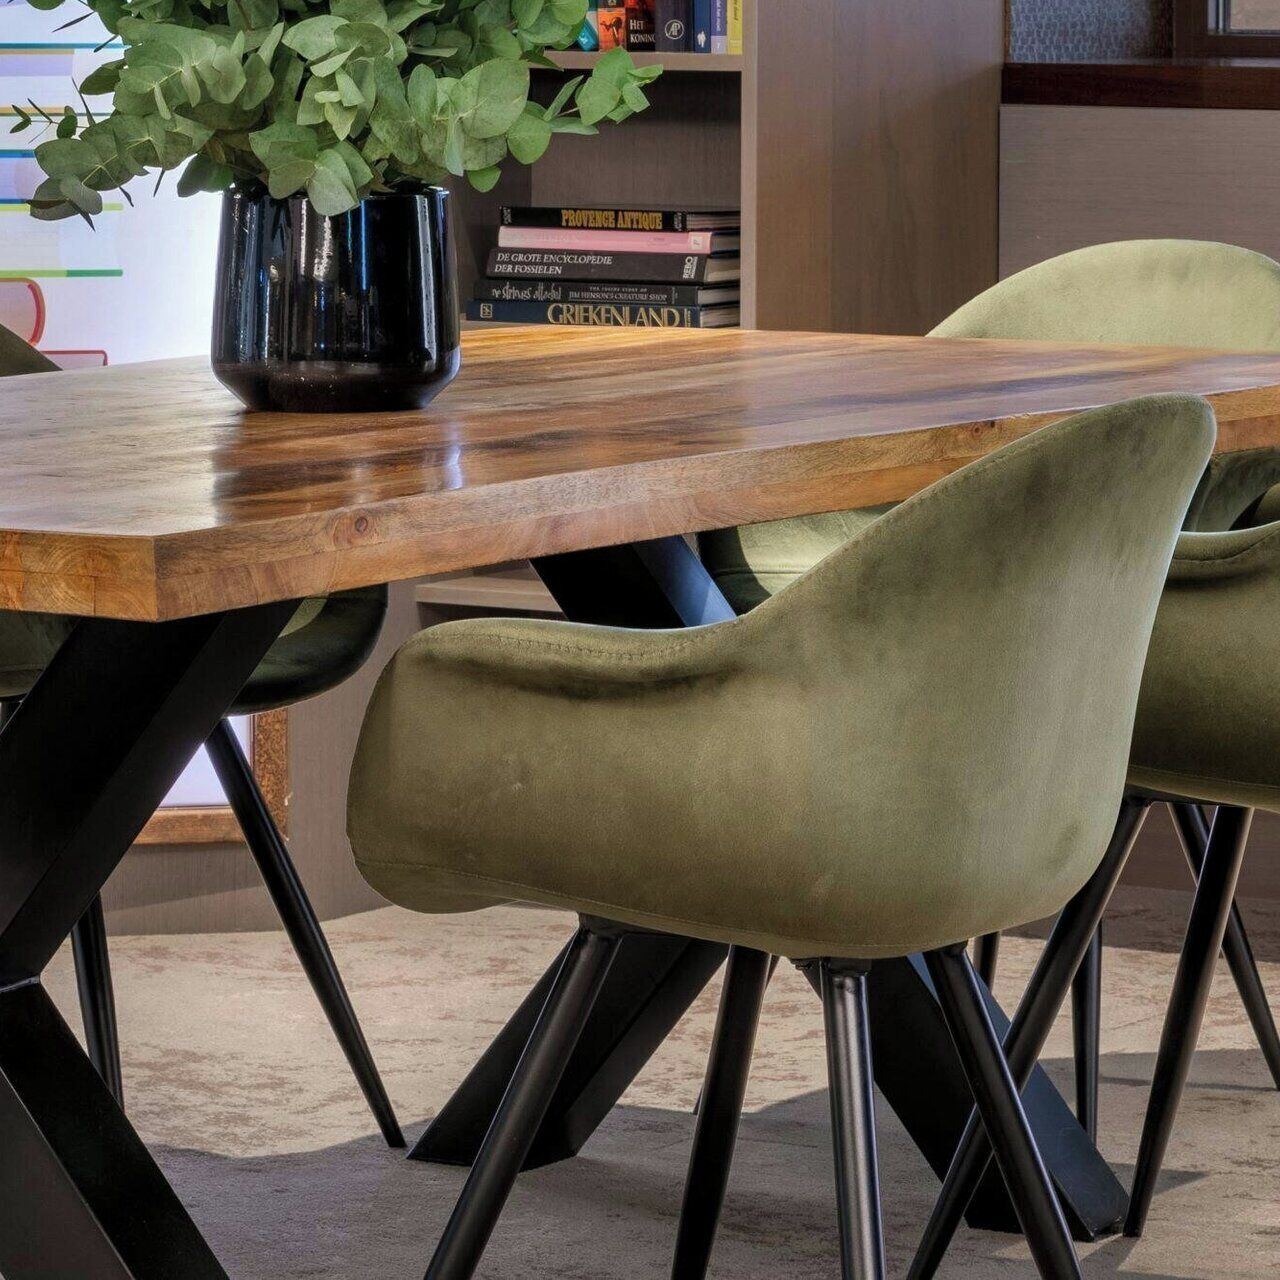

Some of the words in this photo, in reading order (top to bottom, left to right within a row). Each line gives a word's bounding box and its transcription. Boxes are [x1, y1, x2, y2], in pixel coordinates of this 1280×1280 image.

[561, 209, 615, 228] PROVENCE
[617, 211, 663, 229] ANTIQUE
[497, 252, 511, 263] DE
[511, 252, 542, 264] GROTE
[543, 252, 613, 266] ENCYCLOPEDIE
[494, 264, 513, 274] DER
[513, 264, 563, 275] FOSSIELEN
[569, 291, 580, 300] JIM
[581, 291, 614, 301] HENSON'S
[616, 293, 649, 302] CREATURE
[649, 293, 668, 302] SHOP
[547, 302, 681, 329] GRIEKENLAND
